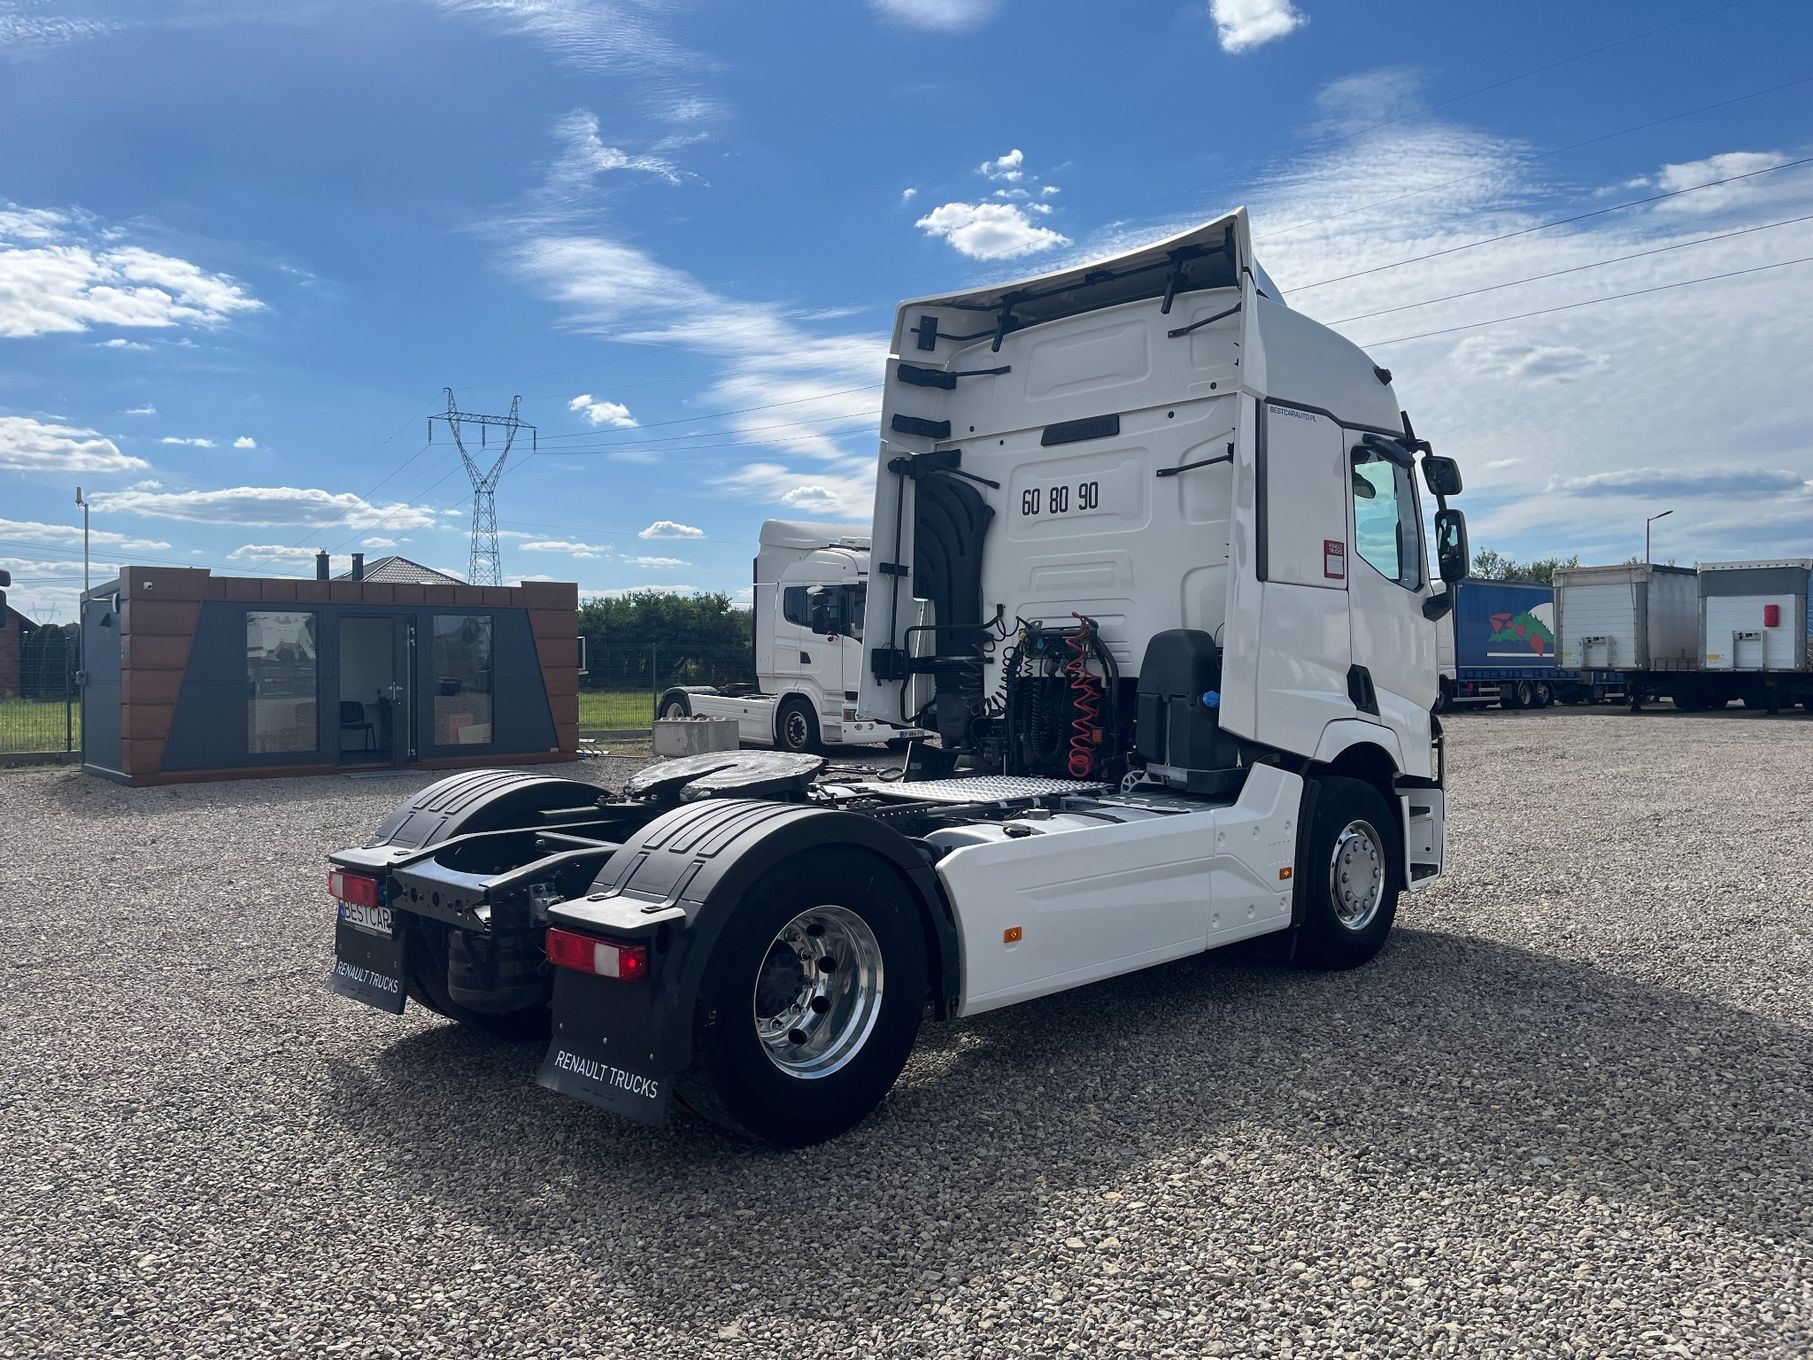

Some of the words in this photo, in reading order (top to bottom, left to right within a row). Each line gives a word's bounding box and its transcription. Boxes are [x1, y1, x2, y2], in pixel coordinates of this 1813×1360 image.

[1270, 405, 1317, 422] BESTCARAUTO.PL
[1022, 488, 1040, 516] 60
[1050, 485, 1069, 514] 80
[1078, 481, 1098, 510] 90
[336, 961, 369, 982] RENAULT
[369, 971, 399, 993] TRUCKS
[555, 1050, 608, 1082] RENAULT
[609, 1067, 659, 1099] TRUCKS
